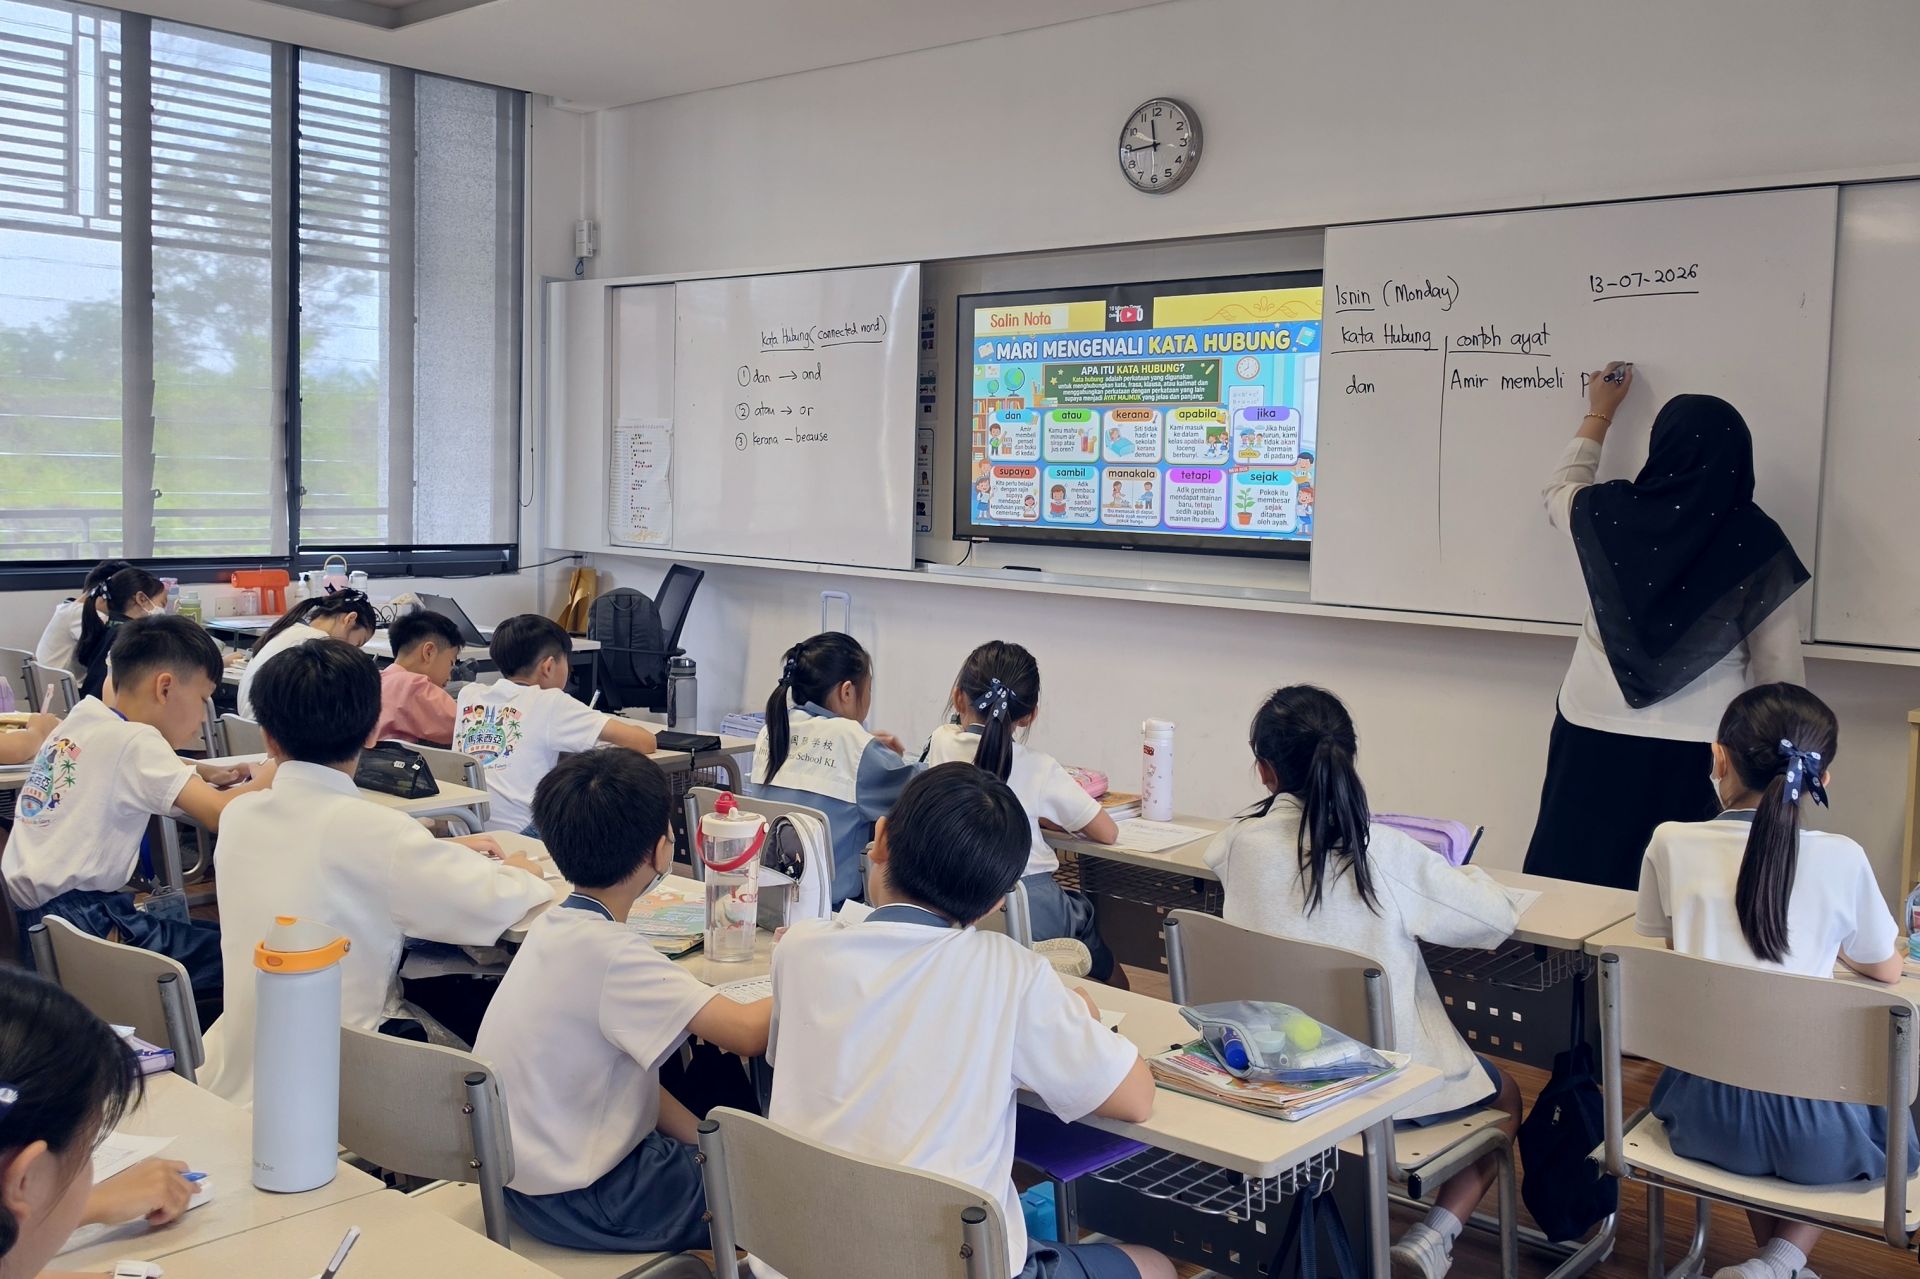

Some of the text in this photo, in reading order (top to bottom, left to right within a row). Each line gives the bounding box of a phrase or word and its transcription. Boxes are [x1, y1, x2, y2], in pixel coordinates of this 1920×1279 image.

[1152, 107, 1162, 117] 12
[1141, 114, 1147, 122] 11
[1176, 121, 1184, 131] 2
[1130, 128, 1138, 136] 10
[1179, 138, 1188, 147] 3
[1128, 160, 1136, 169] 8
[1175, 155, 1182, 164] 4
[1138, 171, 1144, 180] 7
[1165, 169, 1172, 177] 5
[1151, 174, 1158, 183] 6
[1589, 263, 1698, 293] 13-07-2026
[1336, 275, 1459, 312] Isnin (Monday)
[990, 311, 1051, 328] Salin Nota
[1384, 323, 1431, 351] Hubung
[1456, 322, 1550, 355] contoh ayat
[996, 330, 1291, 360] MARI MENGENALI KATA HUBUNG
[753, 369, 771, 383] dan
[802, 362, 822, 381] and
[1081, 363, 1185, 375] APA ITU KATA HUBUNG?
[1450, 369, 1488, 390] Amir
[1501, 366, 1565, 390] membeli
[1346, 374, 1375, 394] dan
[800, 406, 814, 417] or
[1005, 411, 1021, 420] dan
[1179, 409, 1217, 420] apabila
[1257, 408, 1276, 420] jika
[796, 426, 828, 443] because
[1000, 467, 1030, 477] supaya
[1056, 468, 1085, 476] sambil
[1108, 469, 1155, 478] manakala
[1181, 470, 1211, 481] tetapi
[1250, 472, 1279, 483] sejak
[1190, 487, 1215, 496] gembira
[1169, 494, 1199, 502] mendapat
[1265, 504, 1282, 512] sejak
[1272, 519, 1288, 527] ayah.
[797, 752, 822, 765] School
[824, 758, 836, 769] KL
